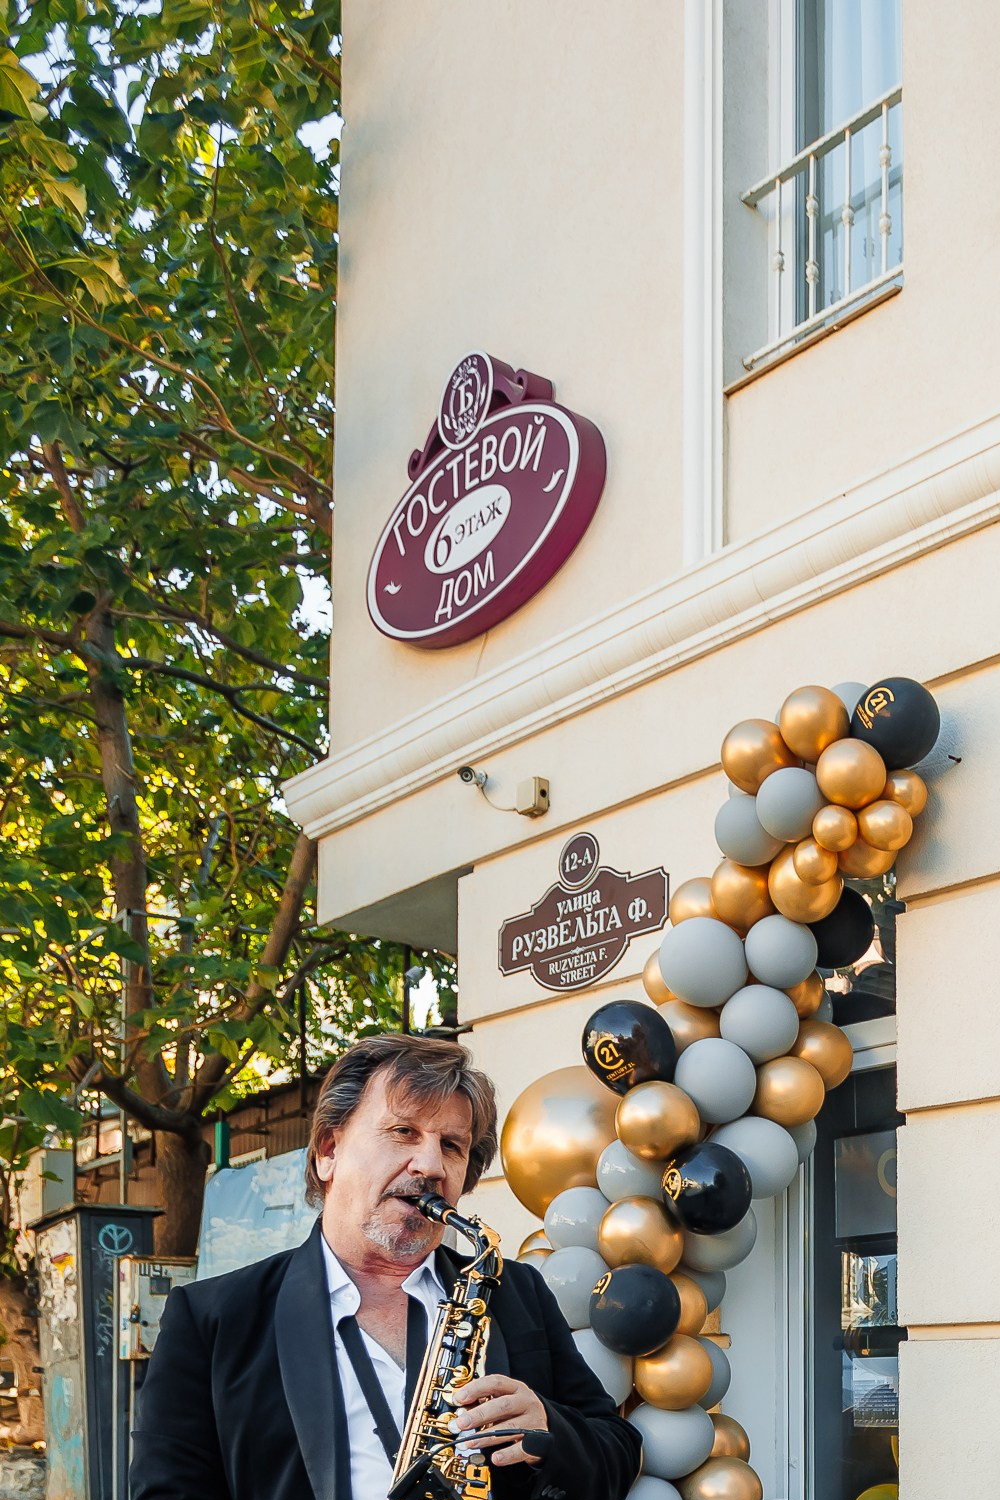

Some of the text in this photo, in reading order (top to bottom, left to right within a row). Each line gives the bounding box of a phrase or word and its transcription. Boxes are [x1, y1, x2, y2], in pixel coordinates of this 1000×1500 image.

[392, 415, 548, 557] ГОСТЕВОЙ
[433, 496, 504, 568] 6 ЭТАЖ
[434, 550, 496, 623] ДОМ
[511, 897, 653, 961] РУЗВЕЛЬТА Ф.
[556, 889, 602, 922] улица
[548, 947, 608, 976] RUZVELTA F.
[560, 963, 597, 985] STREET
[600, 1043, 620, 1063] 21
